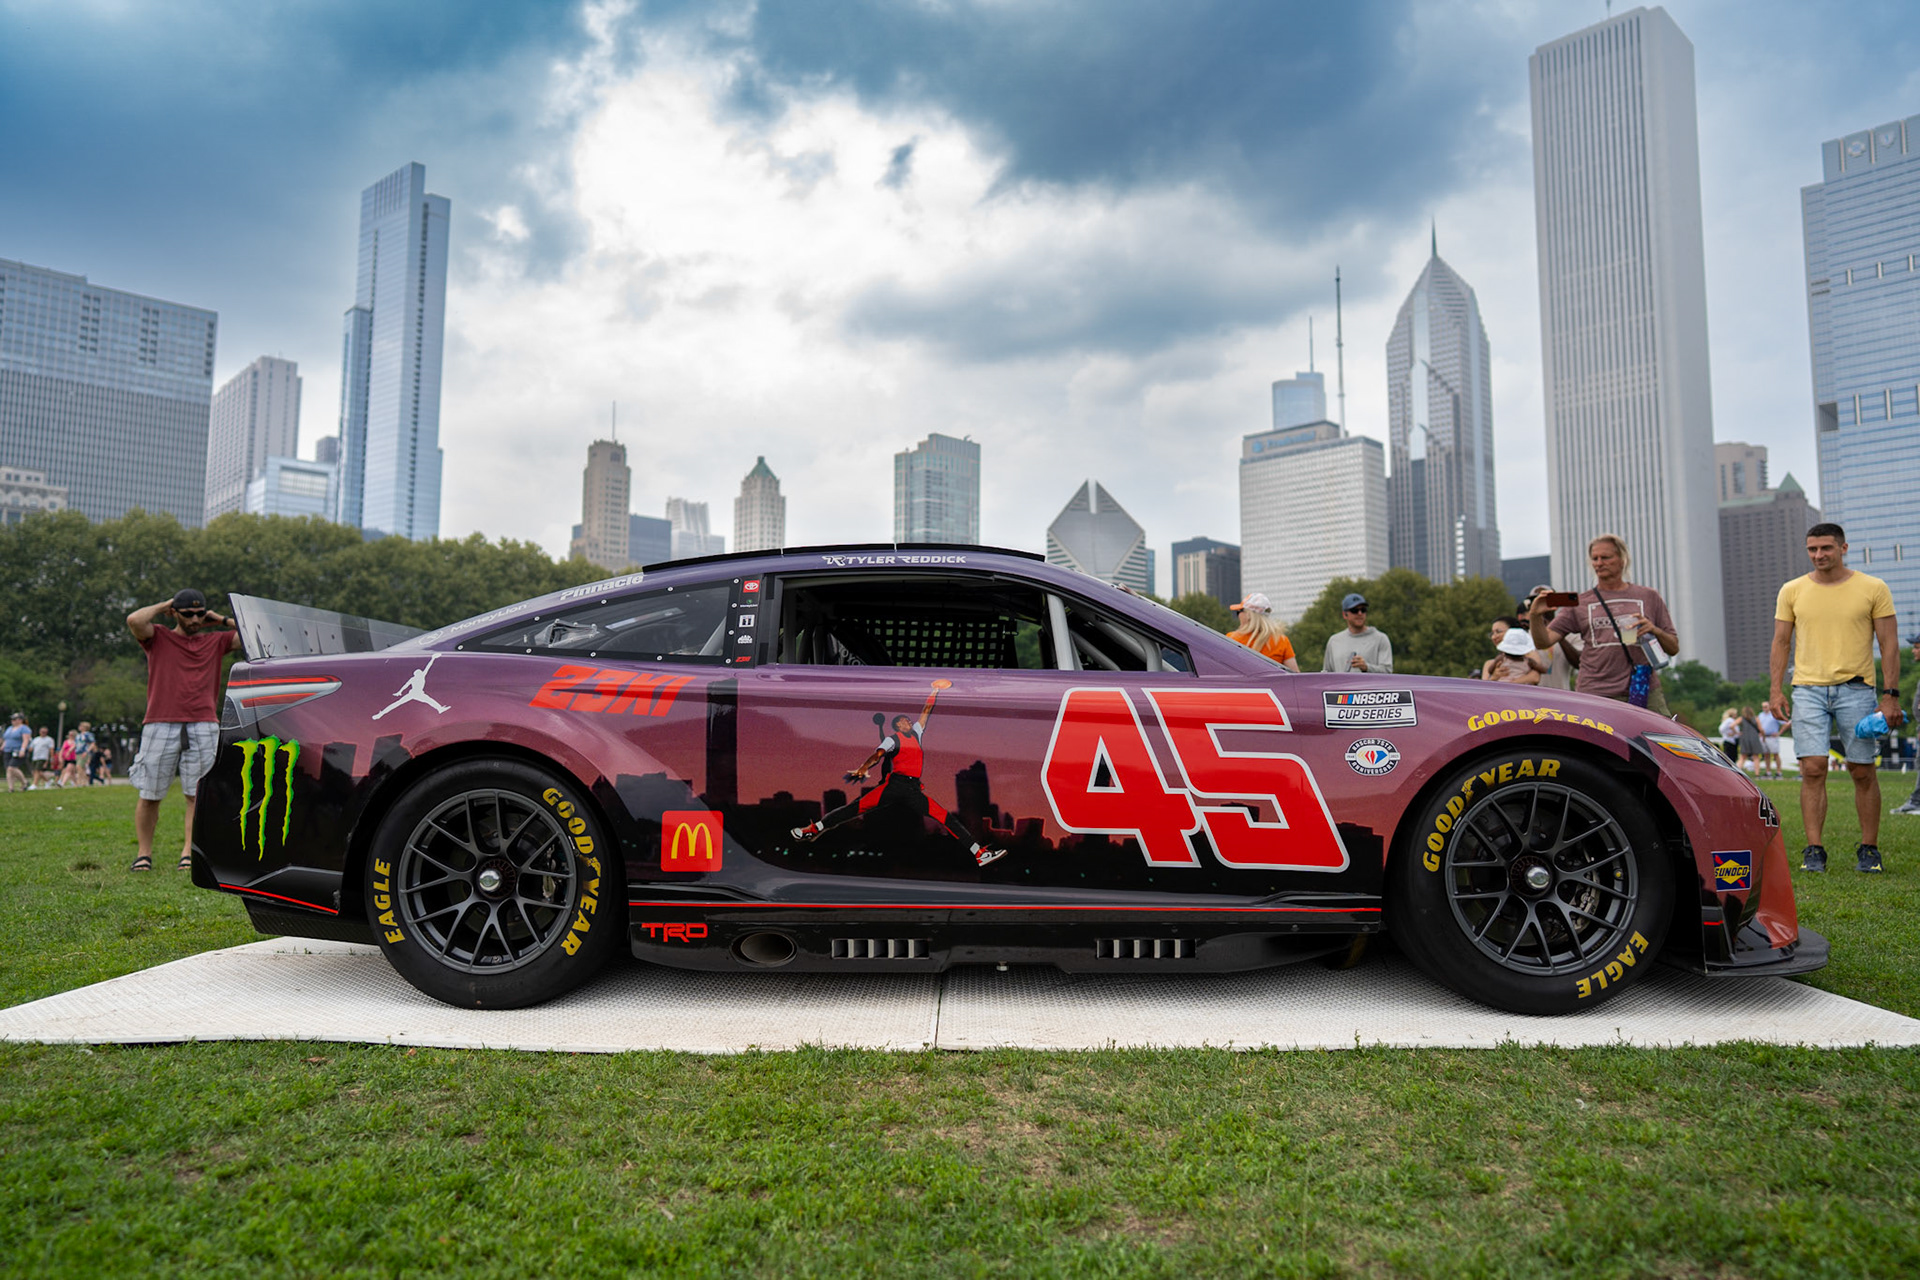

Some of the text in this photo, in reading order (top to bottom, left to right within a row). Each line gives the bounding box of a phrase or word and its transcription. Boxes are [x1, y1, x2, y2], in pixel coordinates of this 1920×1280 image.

[847, 556, 896, 565] TYLER
[897, 555, 967, 564] REDDICK
[560, 575, 644, 600] Pinnacle
[450, 604, 528, 632] MoneyLion
[528, 664, 697, 717] 23XI
[1351, 692, 1399, 705] NASCAR
[1337, 708, 1402, 719] CUP SERIES
[1467, 707, 1614, 735] GOODYEAR
[1352, 739, 1375, 750] NASCAR
[1041, 687, 1350, 873] 45
[1351, 761, 1394, 775] ANNIVERSARY
[1423, 759, 1560, 872] GOODYEAR
[542, 788, 601, 956] GOODYEAR
[1714, 866, 1748, 877] SUNOCO
[373, 858, 406, 944] EAGLE
[641, 922, 708, 943] TRD
[1575, 930, 1650, 999] EAGLE
